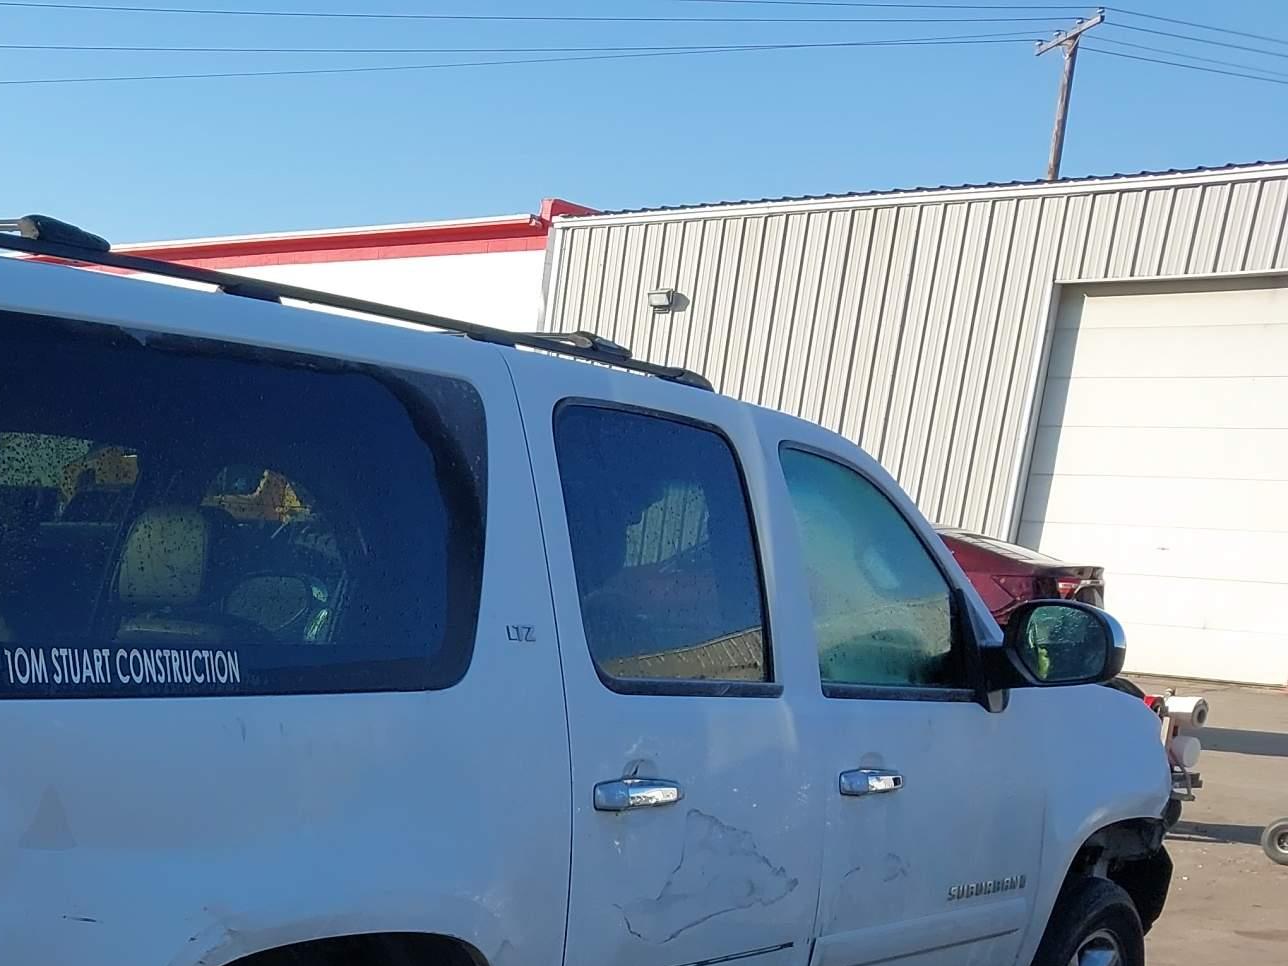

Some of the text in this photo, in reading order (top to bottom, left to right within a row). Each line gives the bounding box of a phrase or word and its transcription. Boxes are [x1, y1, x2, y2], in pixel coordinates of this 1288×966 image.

[505, 624, 537, 642] LTZ
[5, 647, 241, 684] TOM STUART CONSTRUCTION
[947, 874, 1027, 901] SUBURBAN
